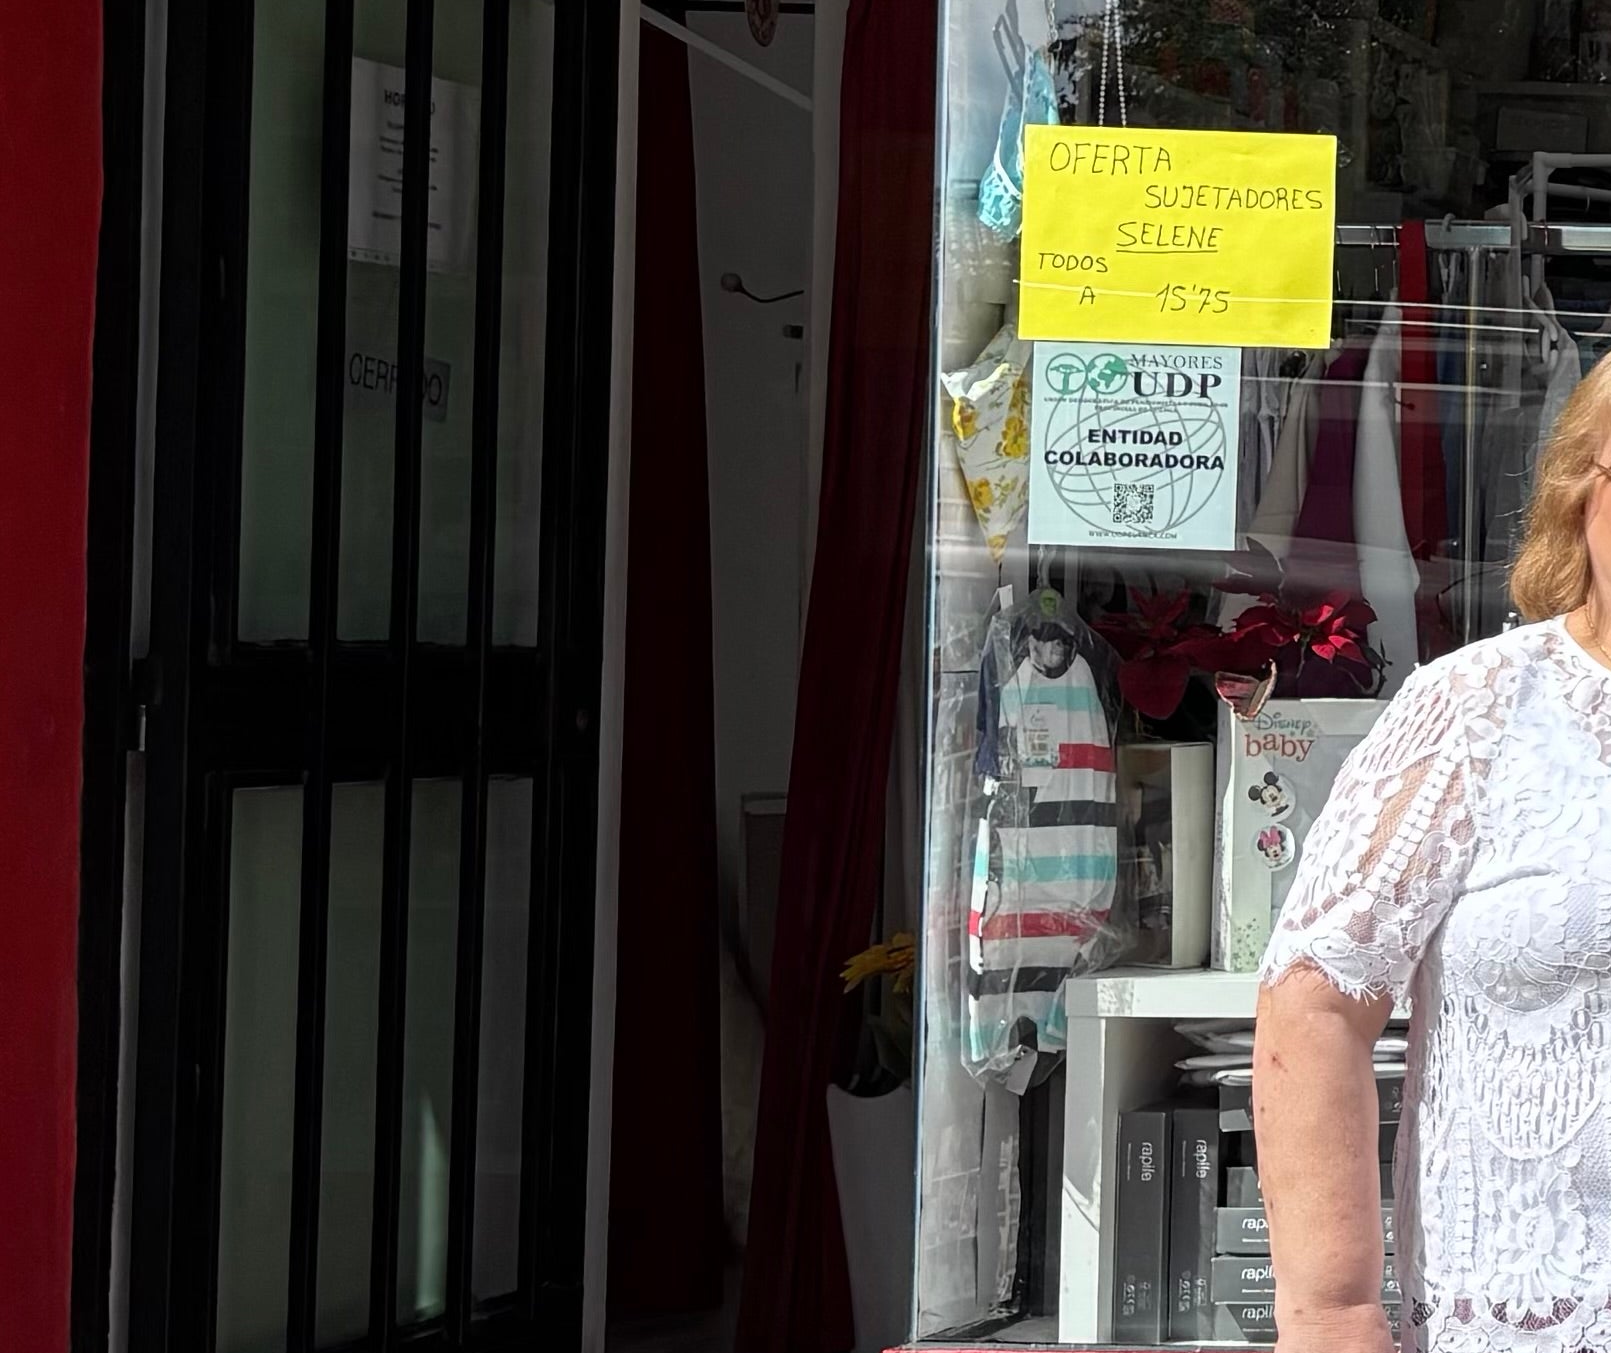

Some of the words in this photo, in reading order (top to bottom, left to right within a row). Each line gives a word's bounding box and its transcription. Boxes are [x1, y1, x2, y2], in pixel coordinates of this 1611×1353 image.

[1049, 141, 1172, 176] OFERTA
[1144, 184, 1323, 211] SUJETADORES
[1116, 221, 1224, 250] SELENE
[1038, 252, 1109, 273] TODOS
[1079, 285, 1097, 305] A
[1130, 353, 1223, 370] MAYORES
[1132, 370, 1223, 399] UDP
[1087, 428, 1183, 446] ENTIDAD
[1044, 449, 1225, 471] COLABORADORA
[1245, 733, 1316, 762] baby
